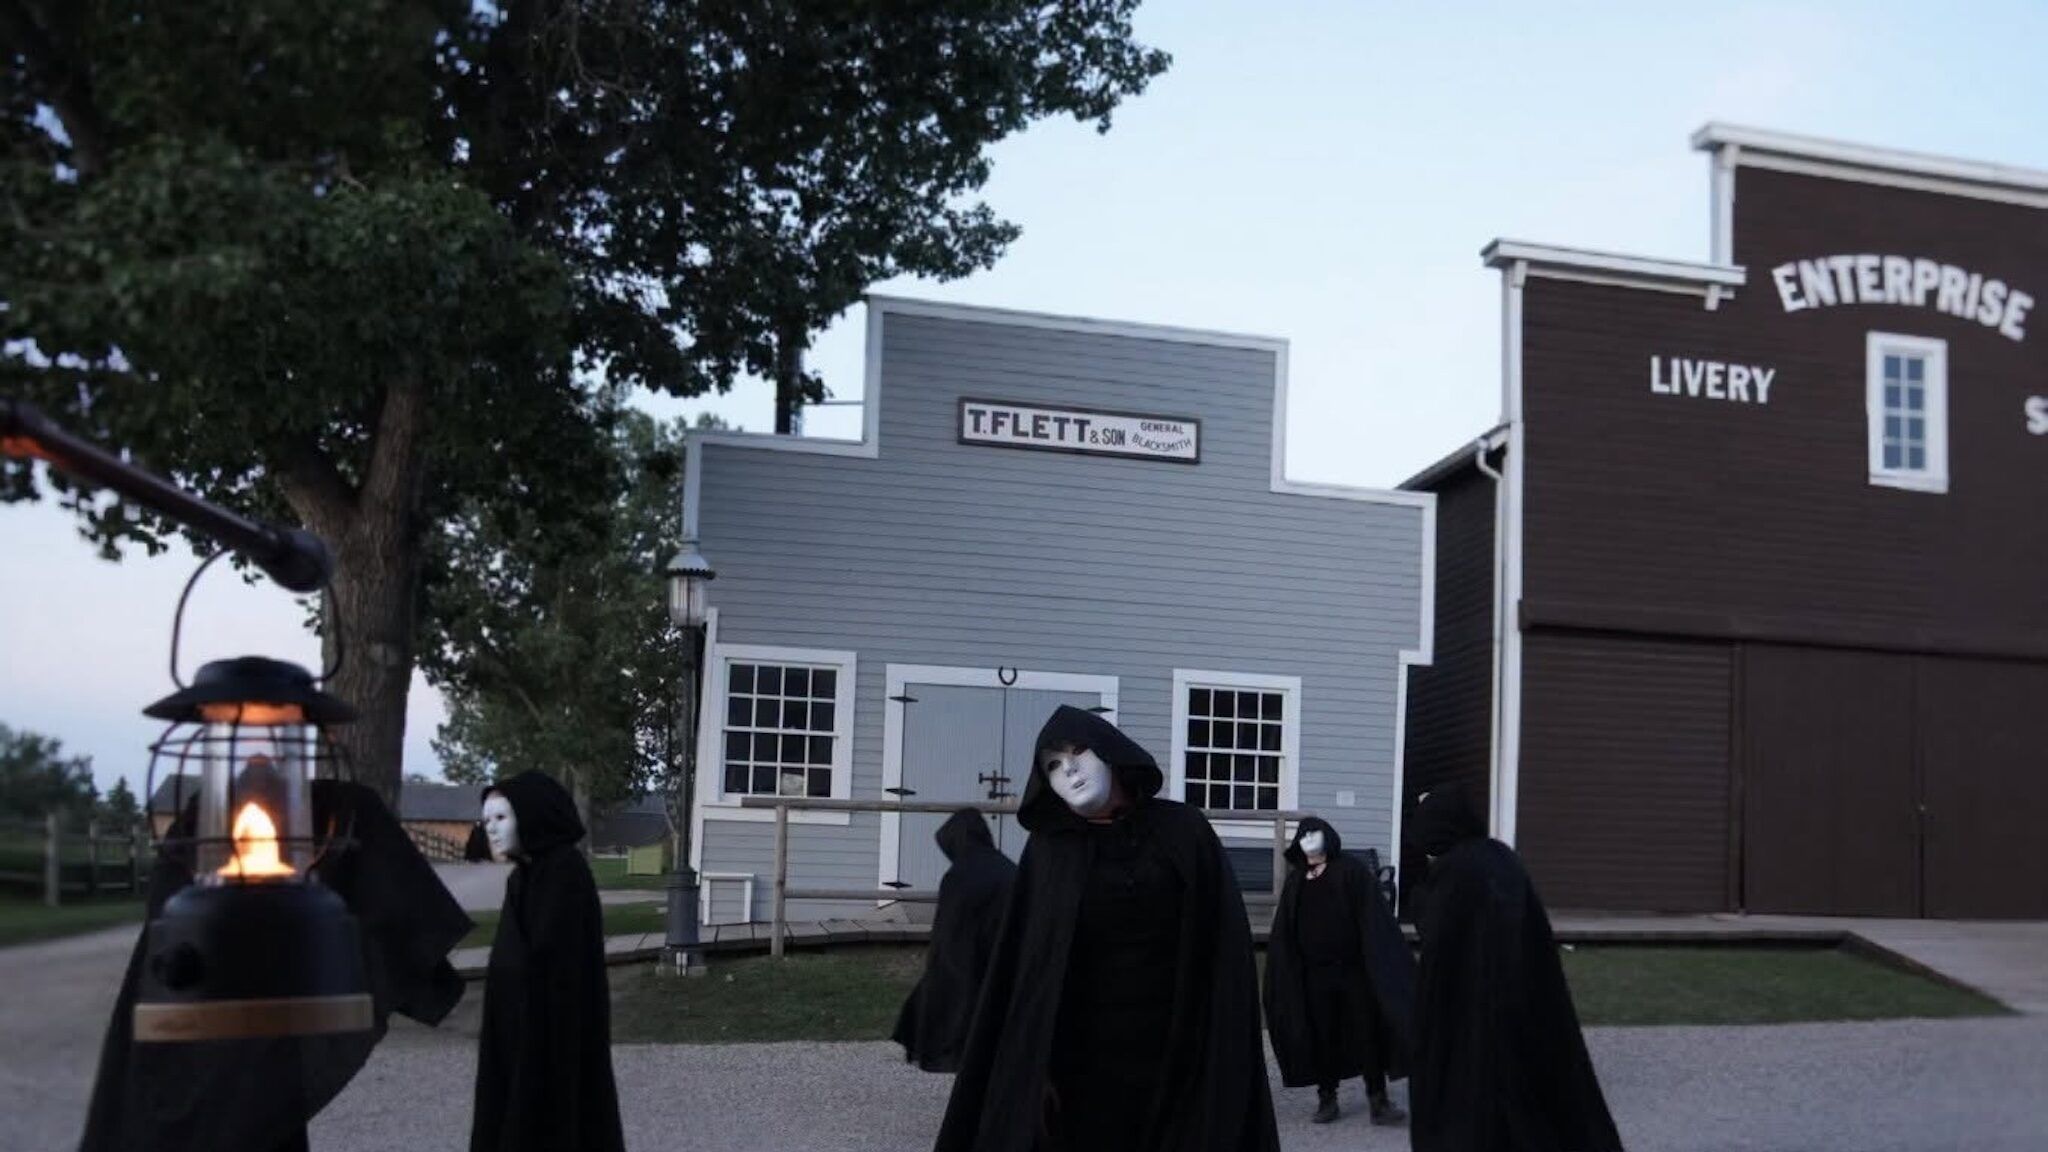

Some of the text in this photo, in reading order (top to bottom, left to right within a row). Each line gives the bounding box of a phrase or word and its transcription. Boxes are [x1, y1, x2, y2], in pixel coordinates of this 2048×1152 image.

[1771, 254, 2035, 342] ENTERPRISE
[1650, 355, 1776, 404] LIVERY
[1089, 429, 1099, 444] &
[1102, 427, 1126, 446] SON
[1140, 421, 1185, 435] GENERAL
[1131, 432, 1192, 452] BLACKSMITH
